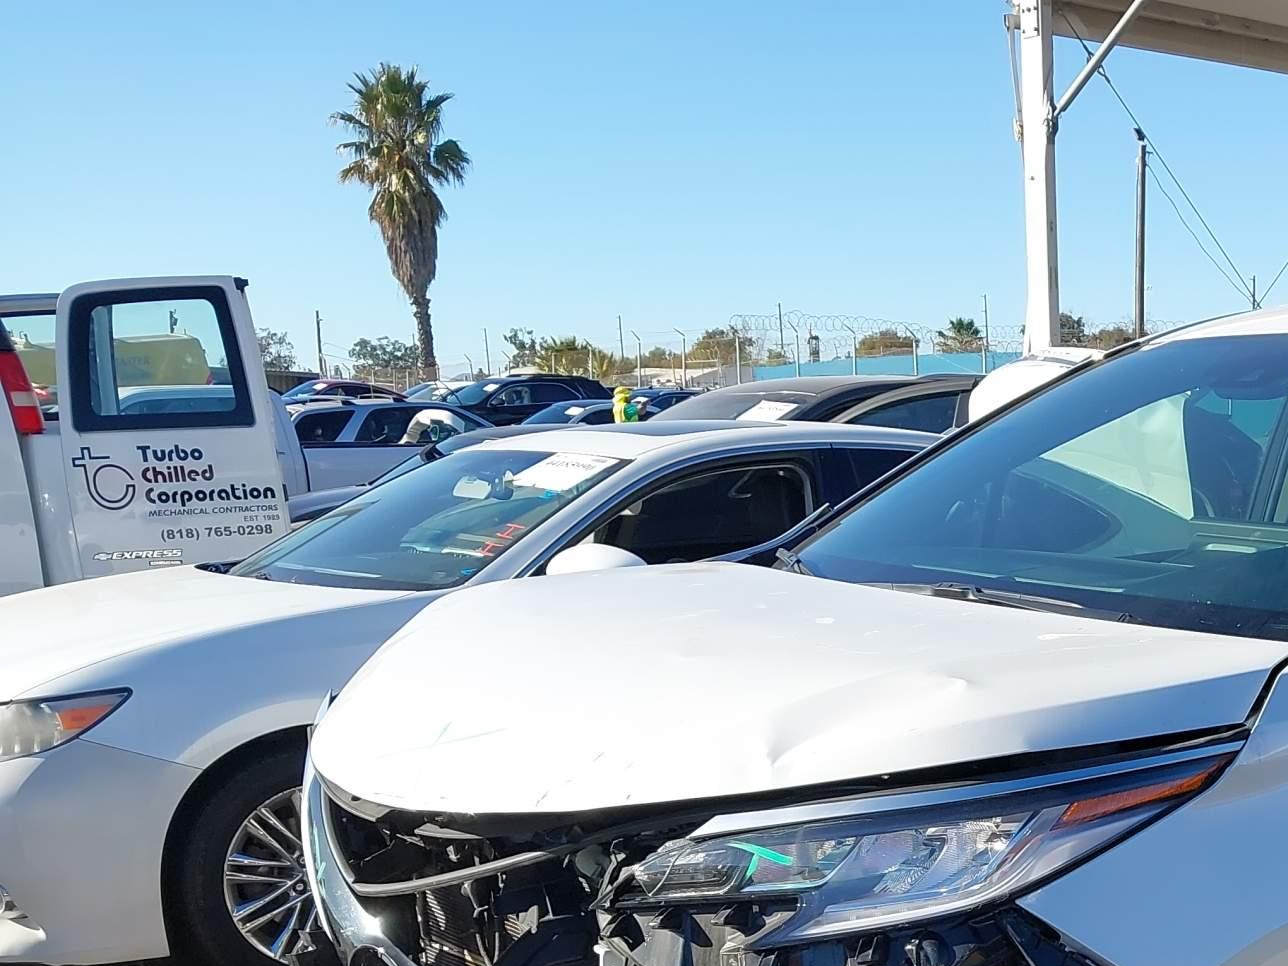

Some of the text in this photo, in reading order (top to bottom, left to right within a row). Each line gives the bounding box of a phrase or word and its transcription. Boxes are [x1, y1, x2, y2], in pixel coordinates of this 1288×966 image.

[136, 445, 203, 462] Turbo
[141, 464, 215, 483] Chilled
[145, 484, 276, 507] Corporation
[148, 504, 279, 517] MECHANICAL CONTRACTORS
[161, 524, 273, 543] (818) 765-0298
[111, 549, 183, 561] EXPRESS
